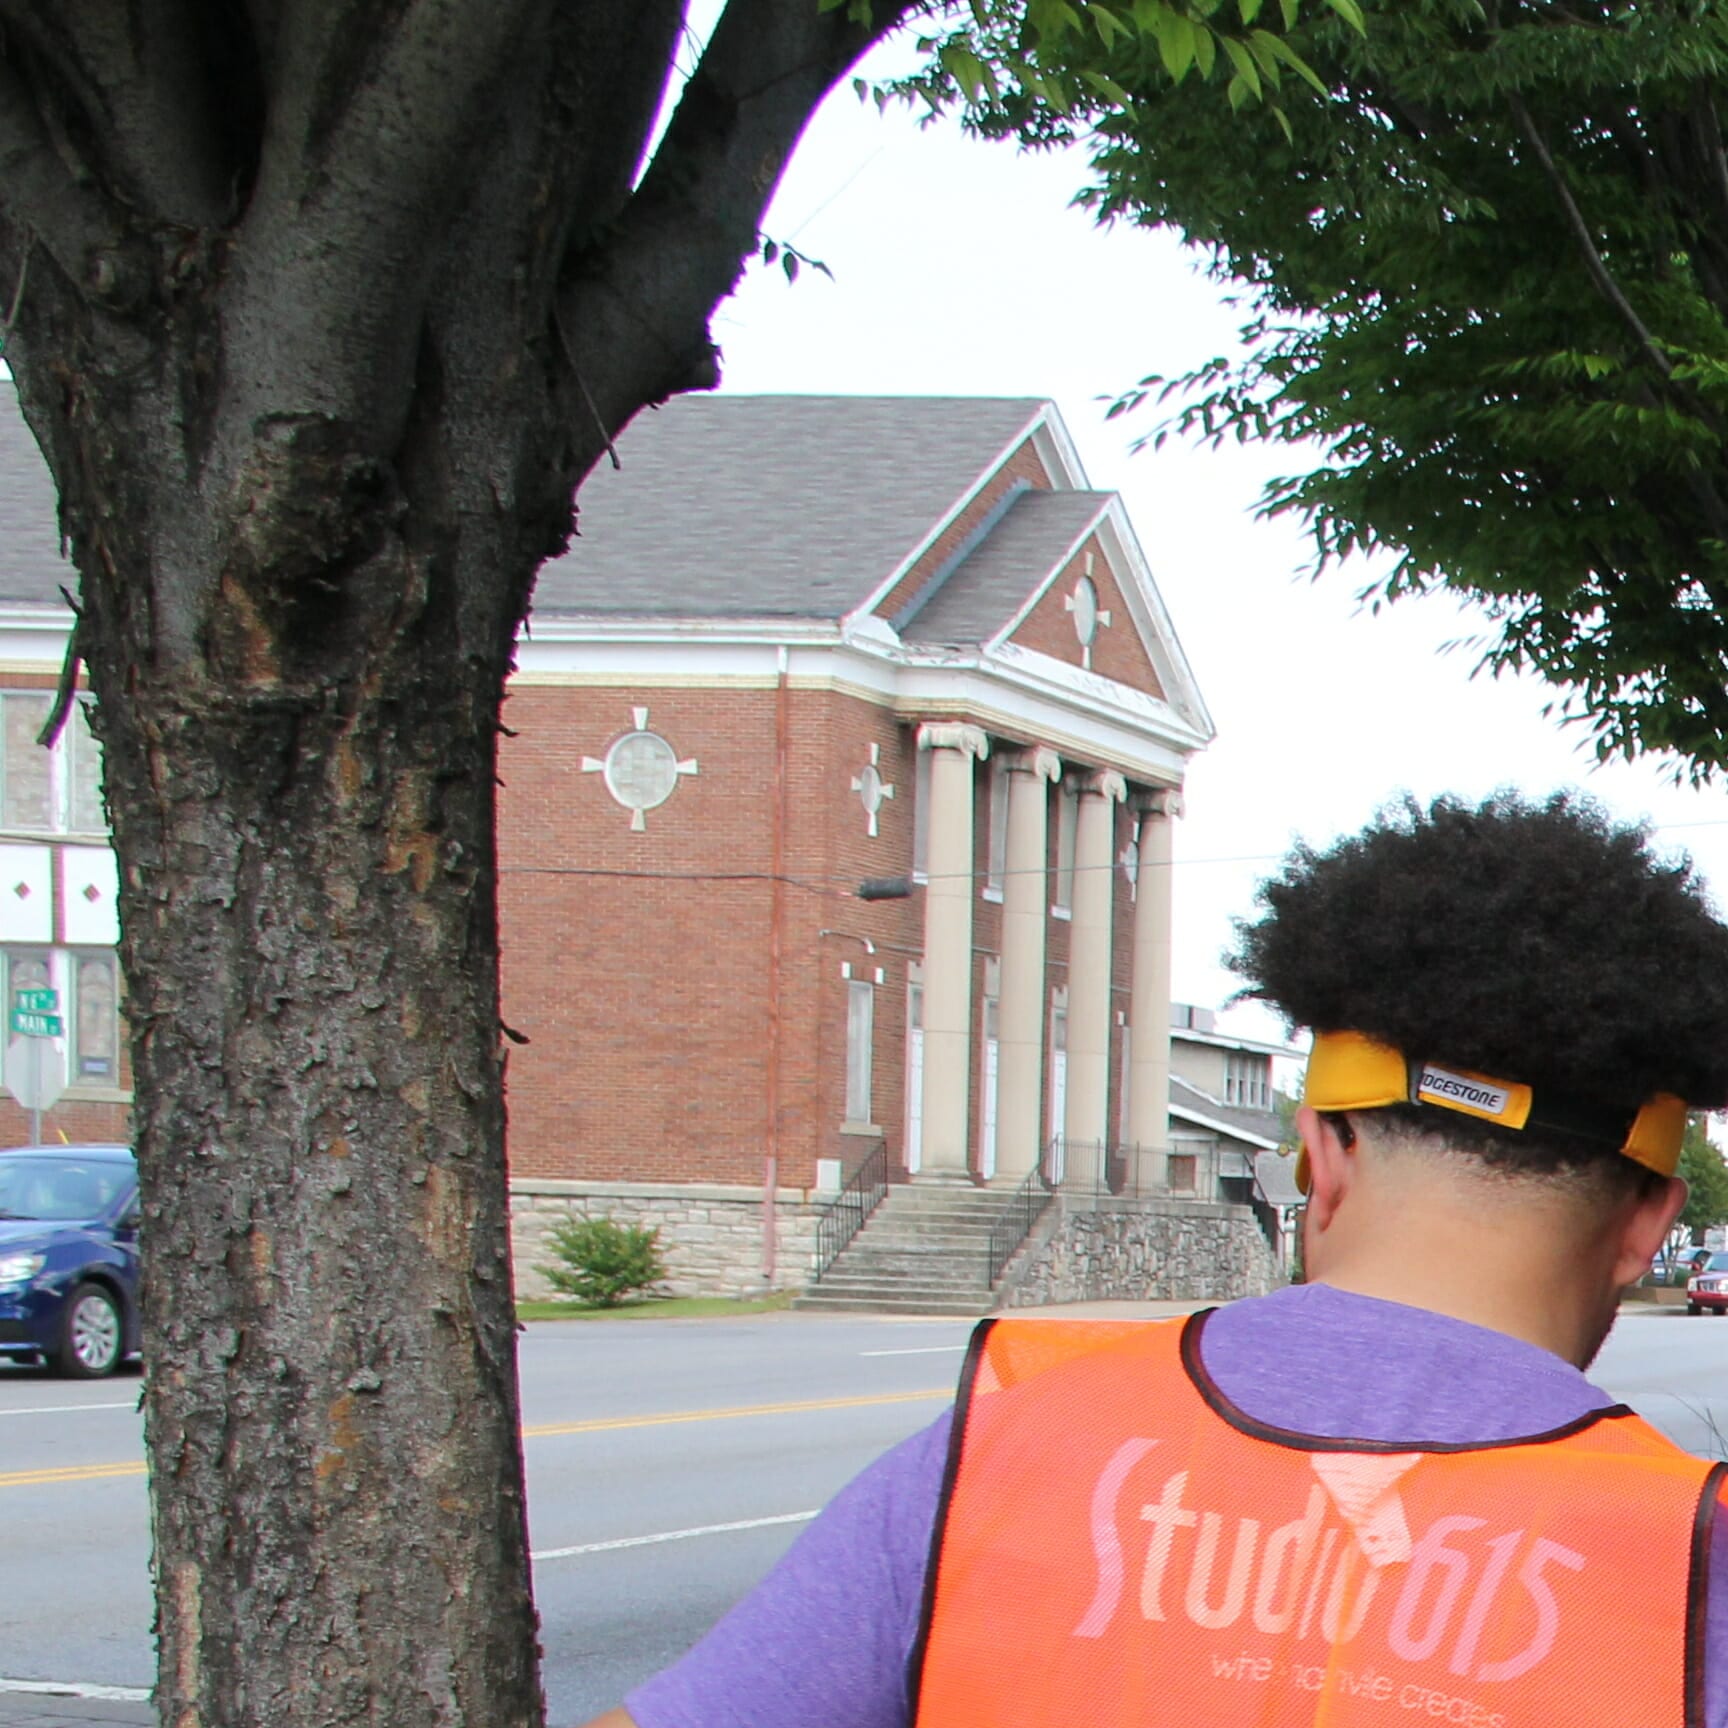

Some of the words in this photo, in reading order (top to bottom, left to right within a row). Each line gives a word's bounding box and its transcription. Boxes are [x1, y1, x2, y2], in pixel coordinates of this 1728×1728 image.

[17, 1013, 47, 1033] MAIN
[1421, 1073, 1501, 1107] DGESTONE
[1073, 1437, 1381, 1645] Studio
[1388, 1515, 1587, 1684] 615
